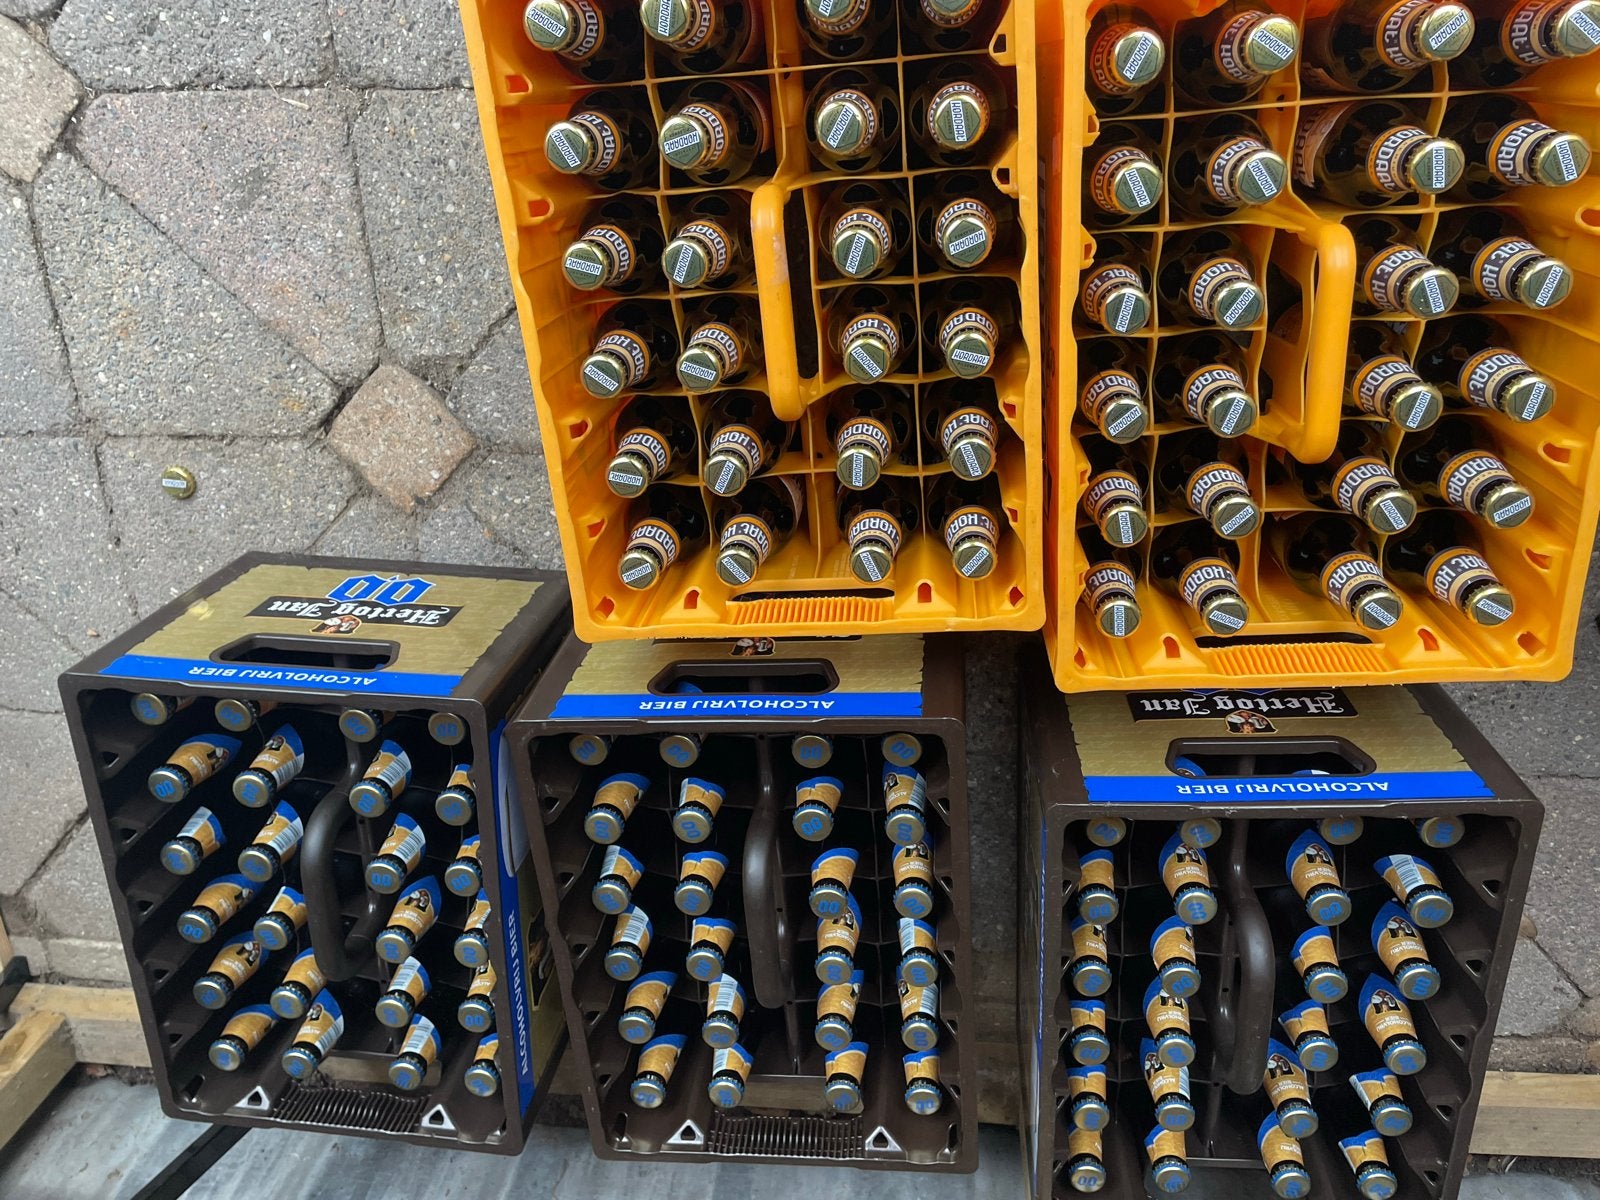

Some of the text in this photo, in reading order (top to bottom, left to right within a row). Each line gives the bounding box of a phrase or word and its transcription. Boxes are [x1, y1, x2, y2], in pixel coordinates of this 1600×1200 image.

[188, 665, 378, 687] ALCOHOLVRIJ BIER
[638, 700, 836, 711] ALCOHOLVRIJ BIER
[1176, 781, 1390, 795] ALCOHOLVRIJ BIER
[507, 909, 529, 1076] ALCOHOLVRIJ BIER
